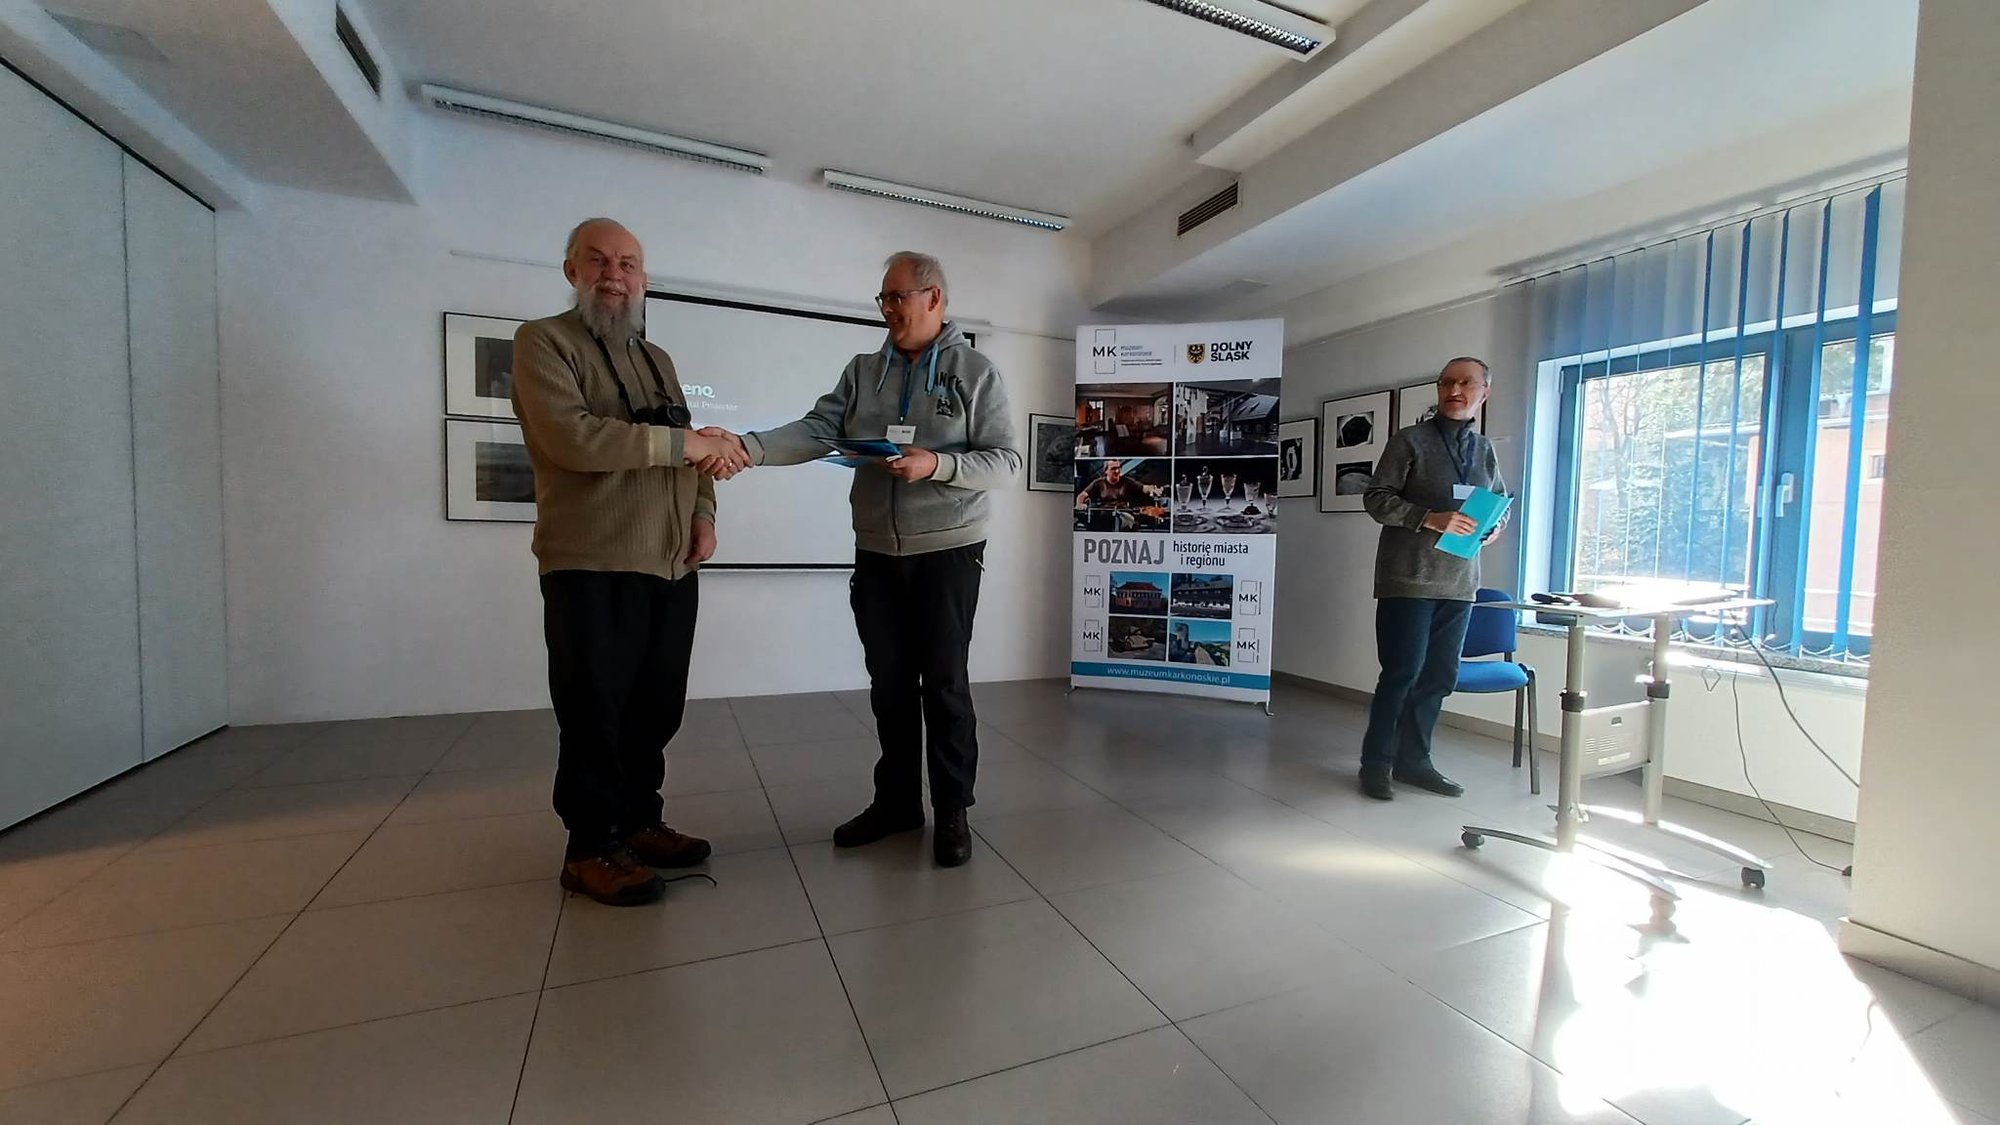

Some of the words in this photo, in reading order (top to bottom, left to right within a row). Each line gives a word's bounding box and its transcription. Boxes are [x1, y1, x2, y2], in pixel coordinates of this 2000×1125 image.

[1093, 346, 1117, 357] MK
[1210, 341, 1253, 352] DOLNY
[1210, 350, 1249, 362] ŚLĄSK
[681, 384, 715, 398] enQ
[1083, 538, 1165, 565] POZNAJ
[1173, 541, 1211, 556] historię
[1213, 542, 1249, 554] miasta
[1180, 554, 1184, 565] i
[1186, 555, 1225, 568] regionu
[1084, 587, 1101, 596] MK
[1238, 593, 1258, 603] MK
[1082, 631, 1100, 640] MK
[1236, 641, 1256, 650] MK
[1107, 667, 1231, 685] www.muzeumkarkonoskie.pl
